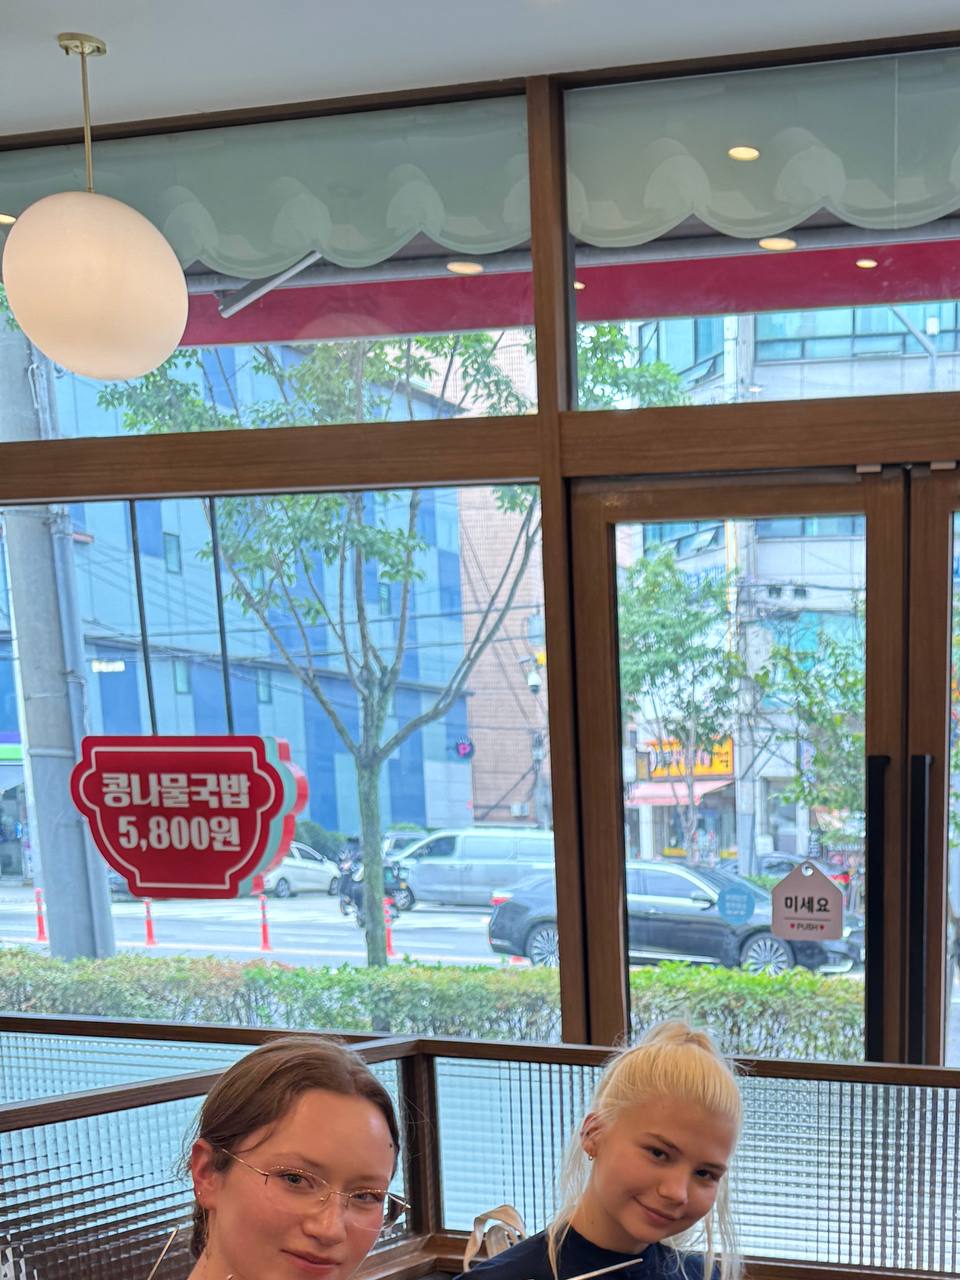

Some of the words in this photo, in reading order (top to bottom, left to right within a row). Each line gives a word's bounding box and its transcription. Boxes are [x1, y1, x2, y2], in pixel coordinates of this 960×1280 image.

[102, 772, 250, 809] 콩나물국밥
[118, 815, 241, 852] 5,800원
[784, 895, 831, 914] 미세요
